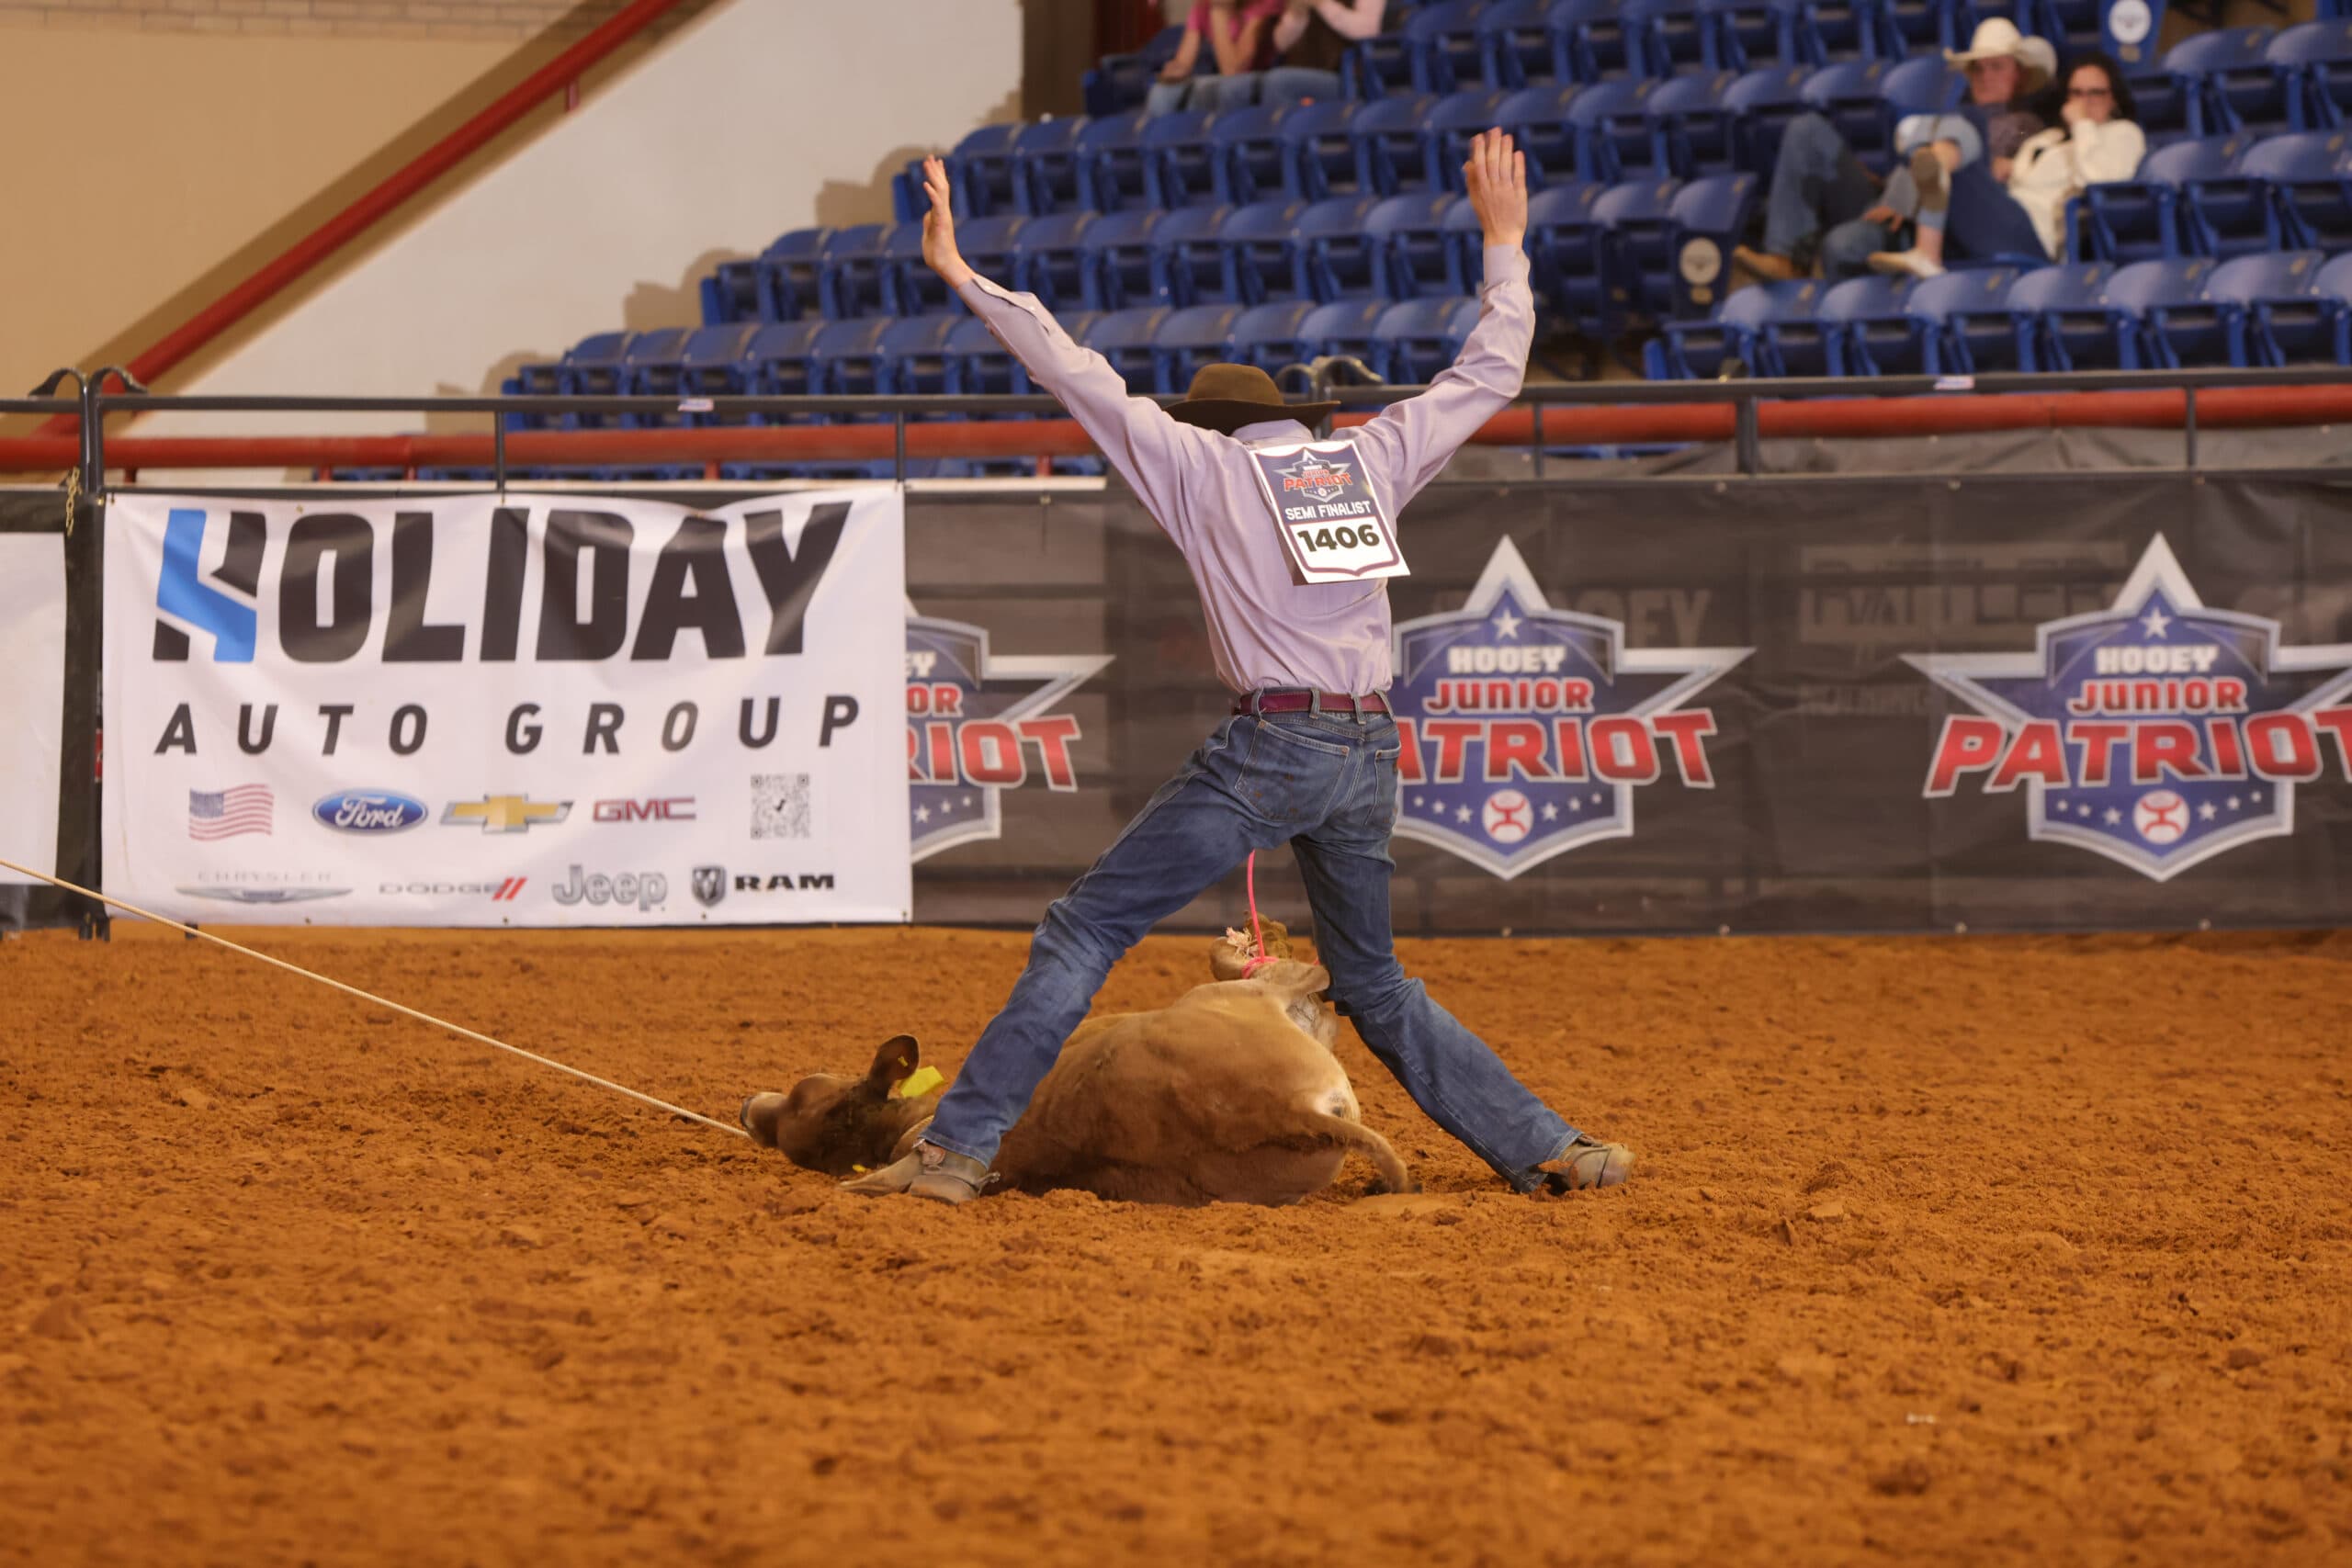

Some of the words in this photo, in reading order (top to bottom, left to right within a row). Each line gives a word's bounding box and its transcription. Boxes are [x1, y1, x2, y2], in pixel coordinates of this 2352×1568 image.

[1283, 472, 1353, 492] PATRIOT
[1285, 505, 1317, 521] SEMI
[1318, 501, 1372, 518] FINALIST
[1297, 524, 1380, 553] 1406
[153, 500, 854, 663] HOLIDAY
[1447, 645, 1569, 674] HOOEY
[2095, 645, 2221, 675] HOOEY
[1422, 676, 1596, 715] JUNIOR
[2066, 676, 2248, 715] JUNIOR
[153, 703, 429, 756] AUTO
[504, 694, 860, 755] GROUP
[334, 796, 405, 829] Ford
[593, 797, 696, 822] GMC
[551, 864, 669, 912] Jeep
[735, 873, 835, 891] RAM
